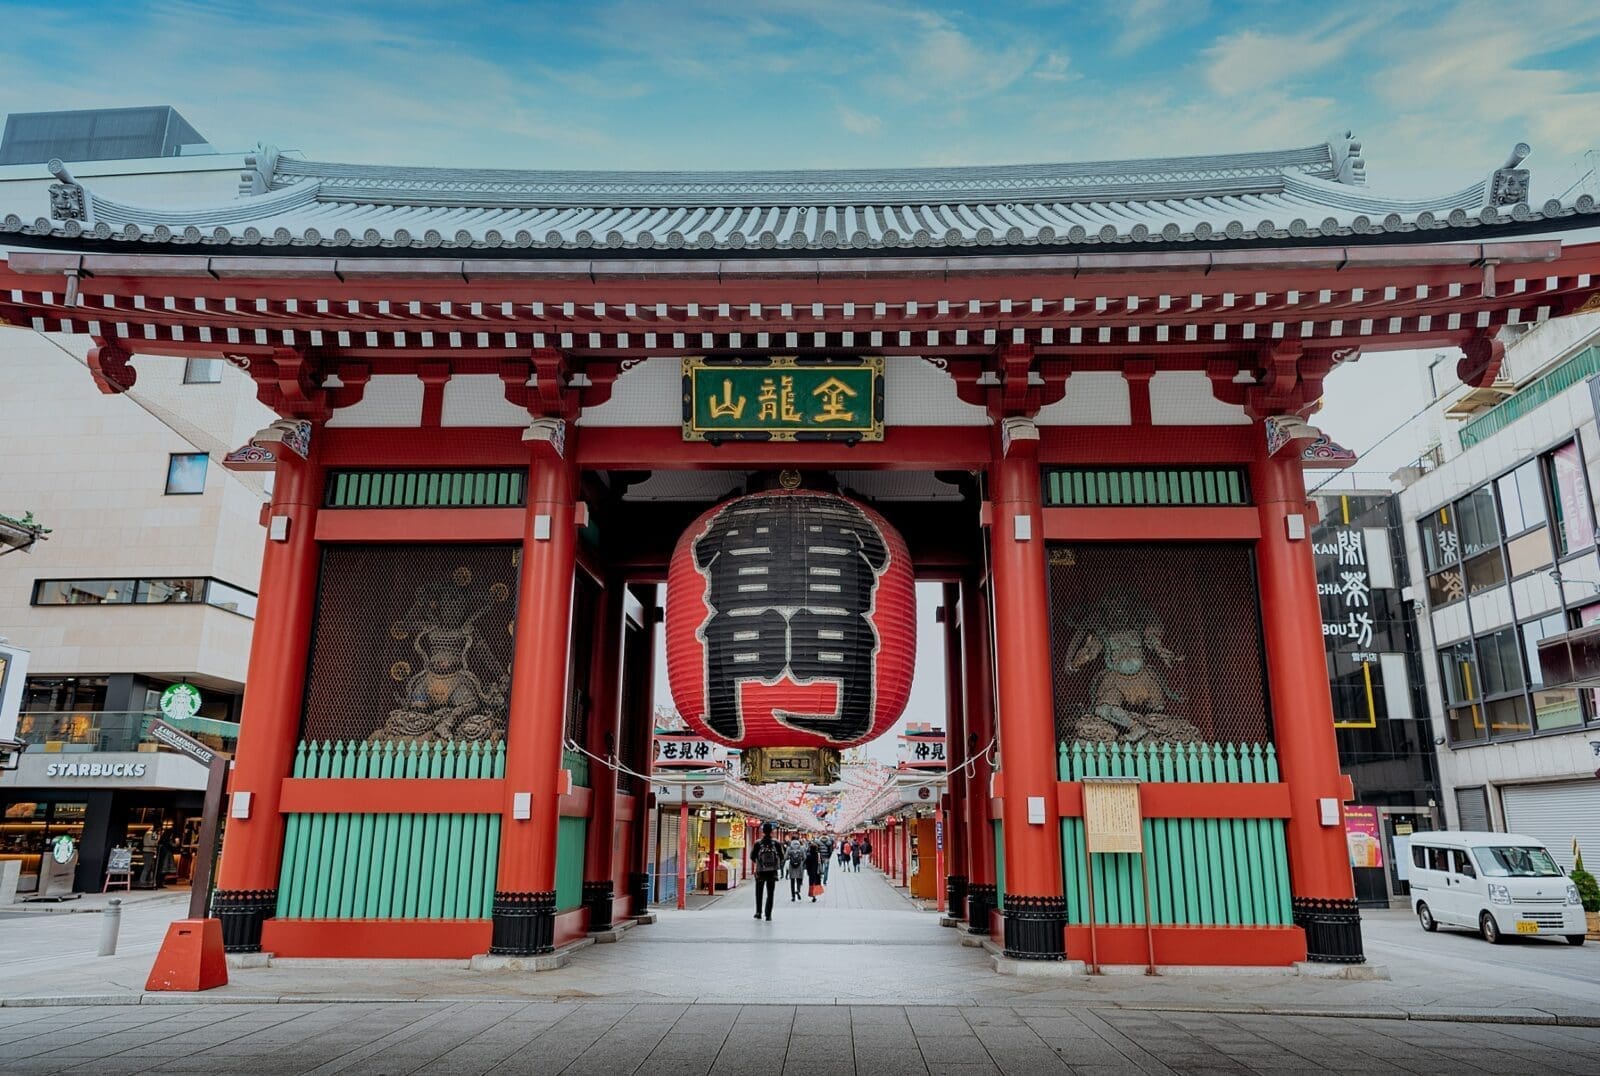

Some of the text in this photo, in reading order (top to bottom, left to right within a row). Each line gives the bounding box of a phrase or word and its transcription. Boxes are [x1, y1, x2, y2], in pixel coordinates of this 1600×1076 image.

[1312, 543, 1338, 554] KAN
[1317, 584, 1342, 595] CHA
[1322, 624, 1347, 636] BOU
[46, 763, 146, 778] STARBUCKS
